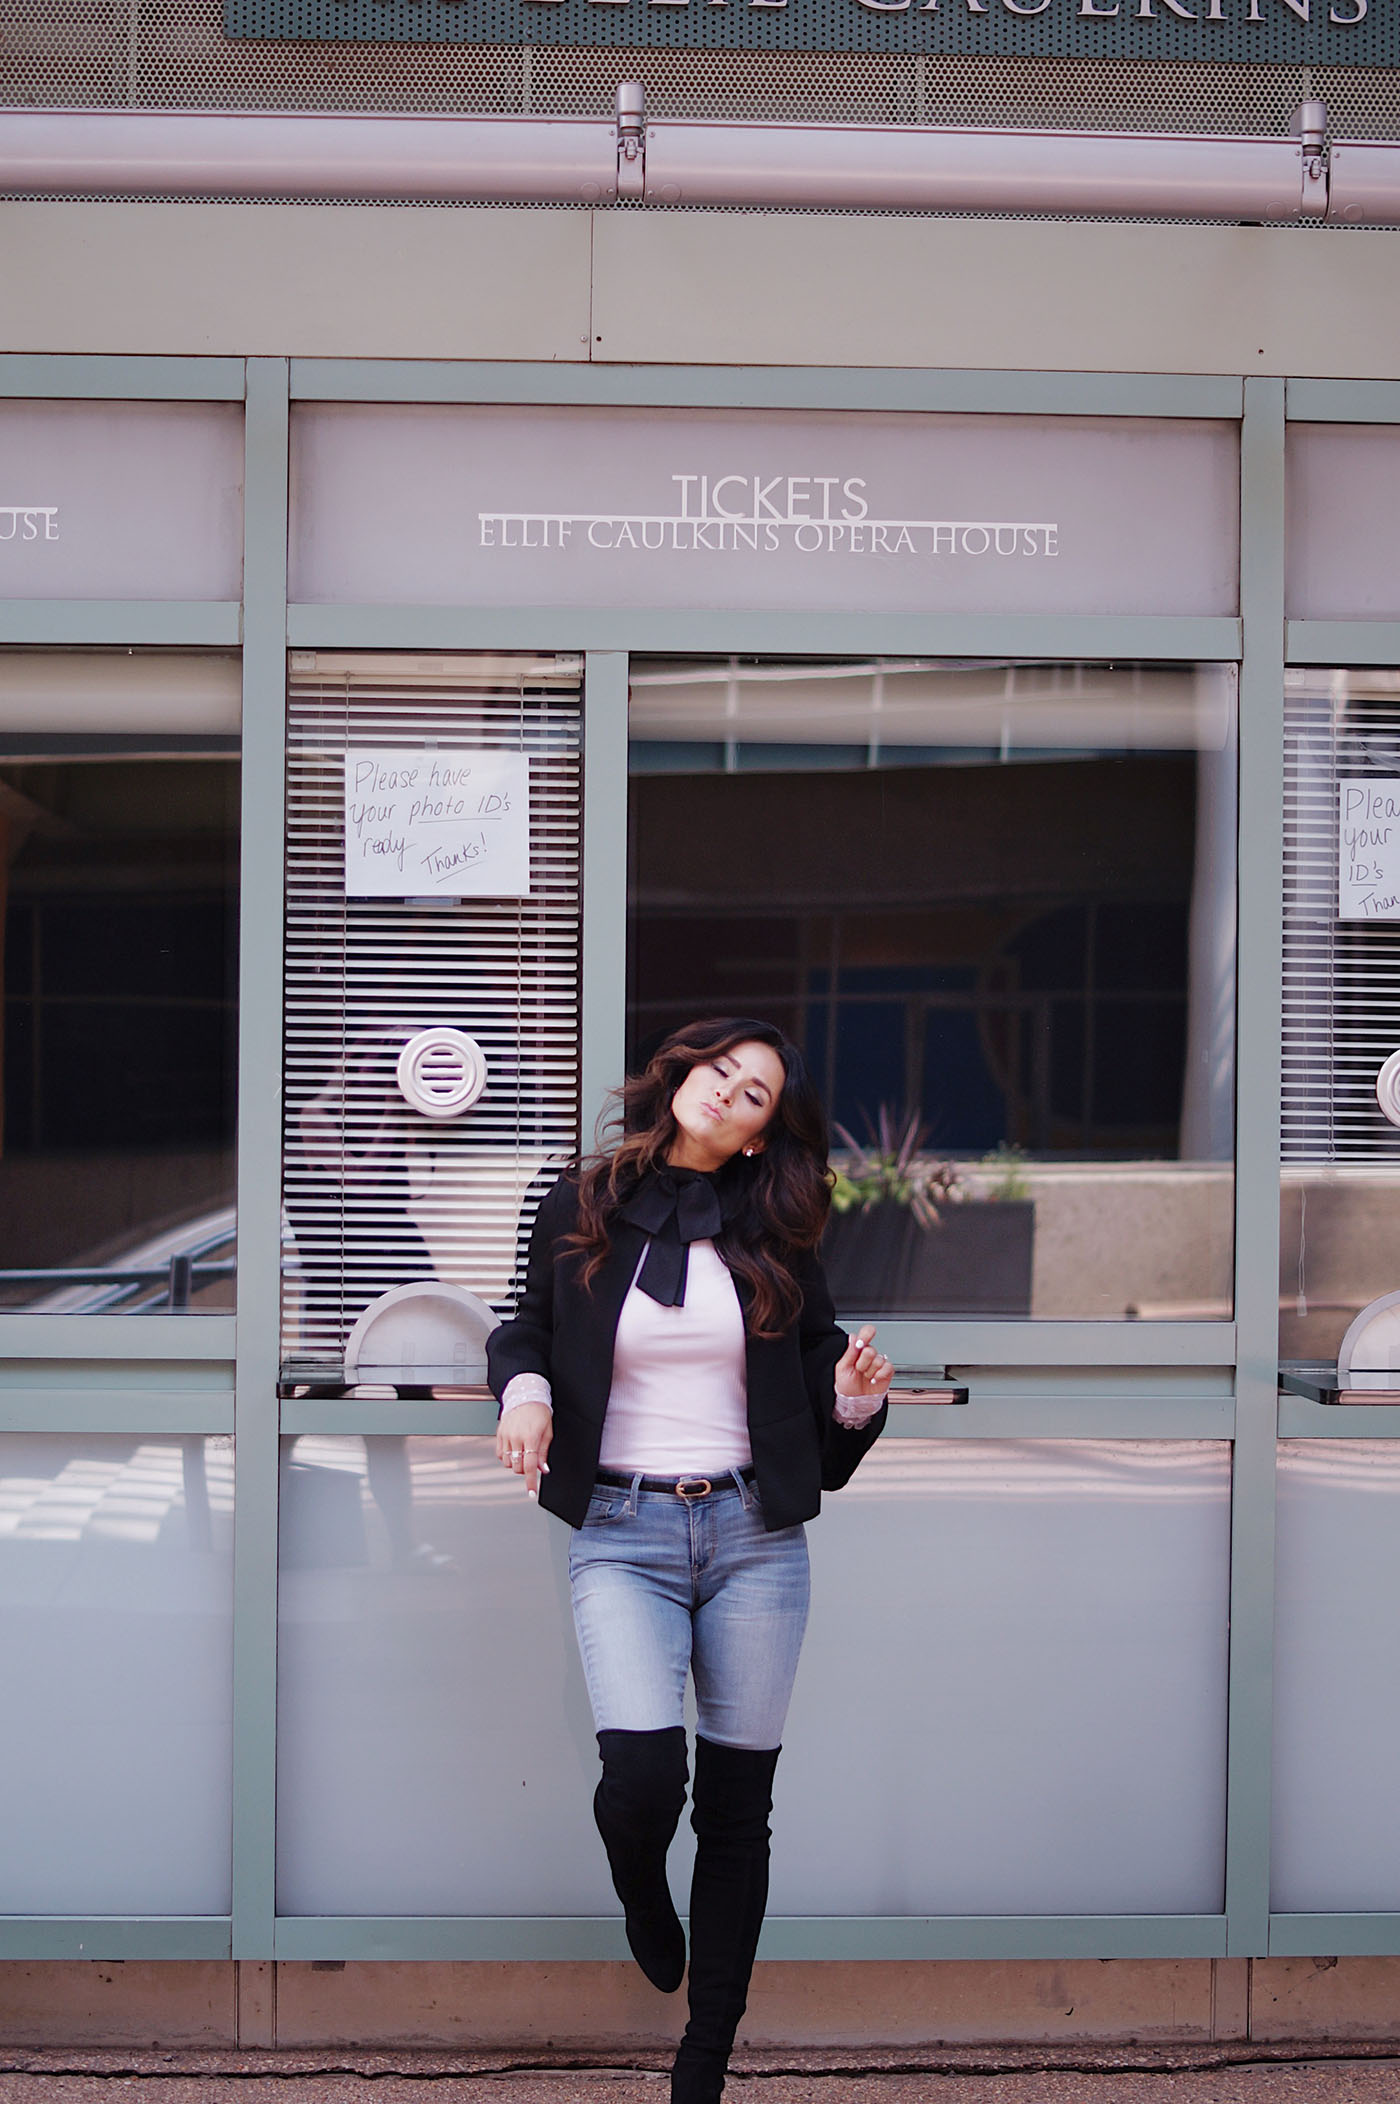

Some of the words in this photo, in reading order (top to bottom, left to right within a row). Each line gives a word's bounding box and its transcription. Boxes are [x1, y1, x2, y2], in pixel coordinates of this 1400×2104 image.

[672, 474, 868, 521] TICKETS
[587, 519, 780, 552] CAULKINS
[794, 523, 918, 554] OPERA
[931, 525, 1059, 557] HOUSE
[355, 760, 419, 793] Please
[428, 761, 472, 788] have
[350, 803, 397, 839] your
[408, 795, 465, 826] photo
[477, 792, 512, 815] ID's
[1344, 827, 1393, 862] your
[1349, 860, 1384, 882] ID's
